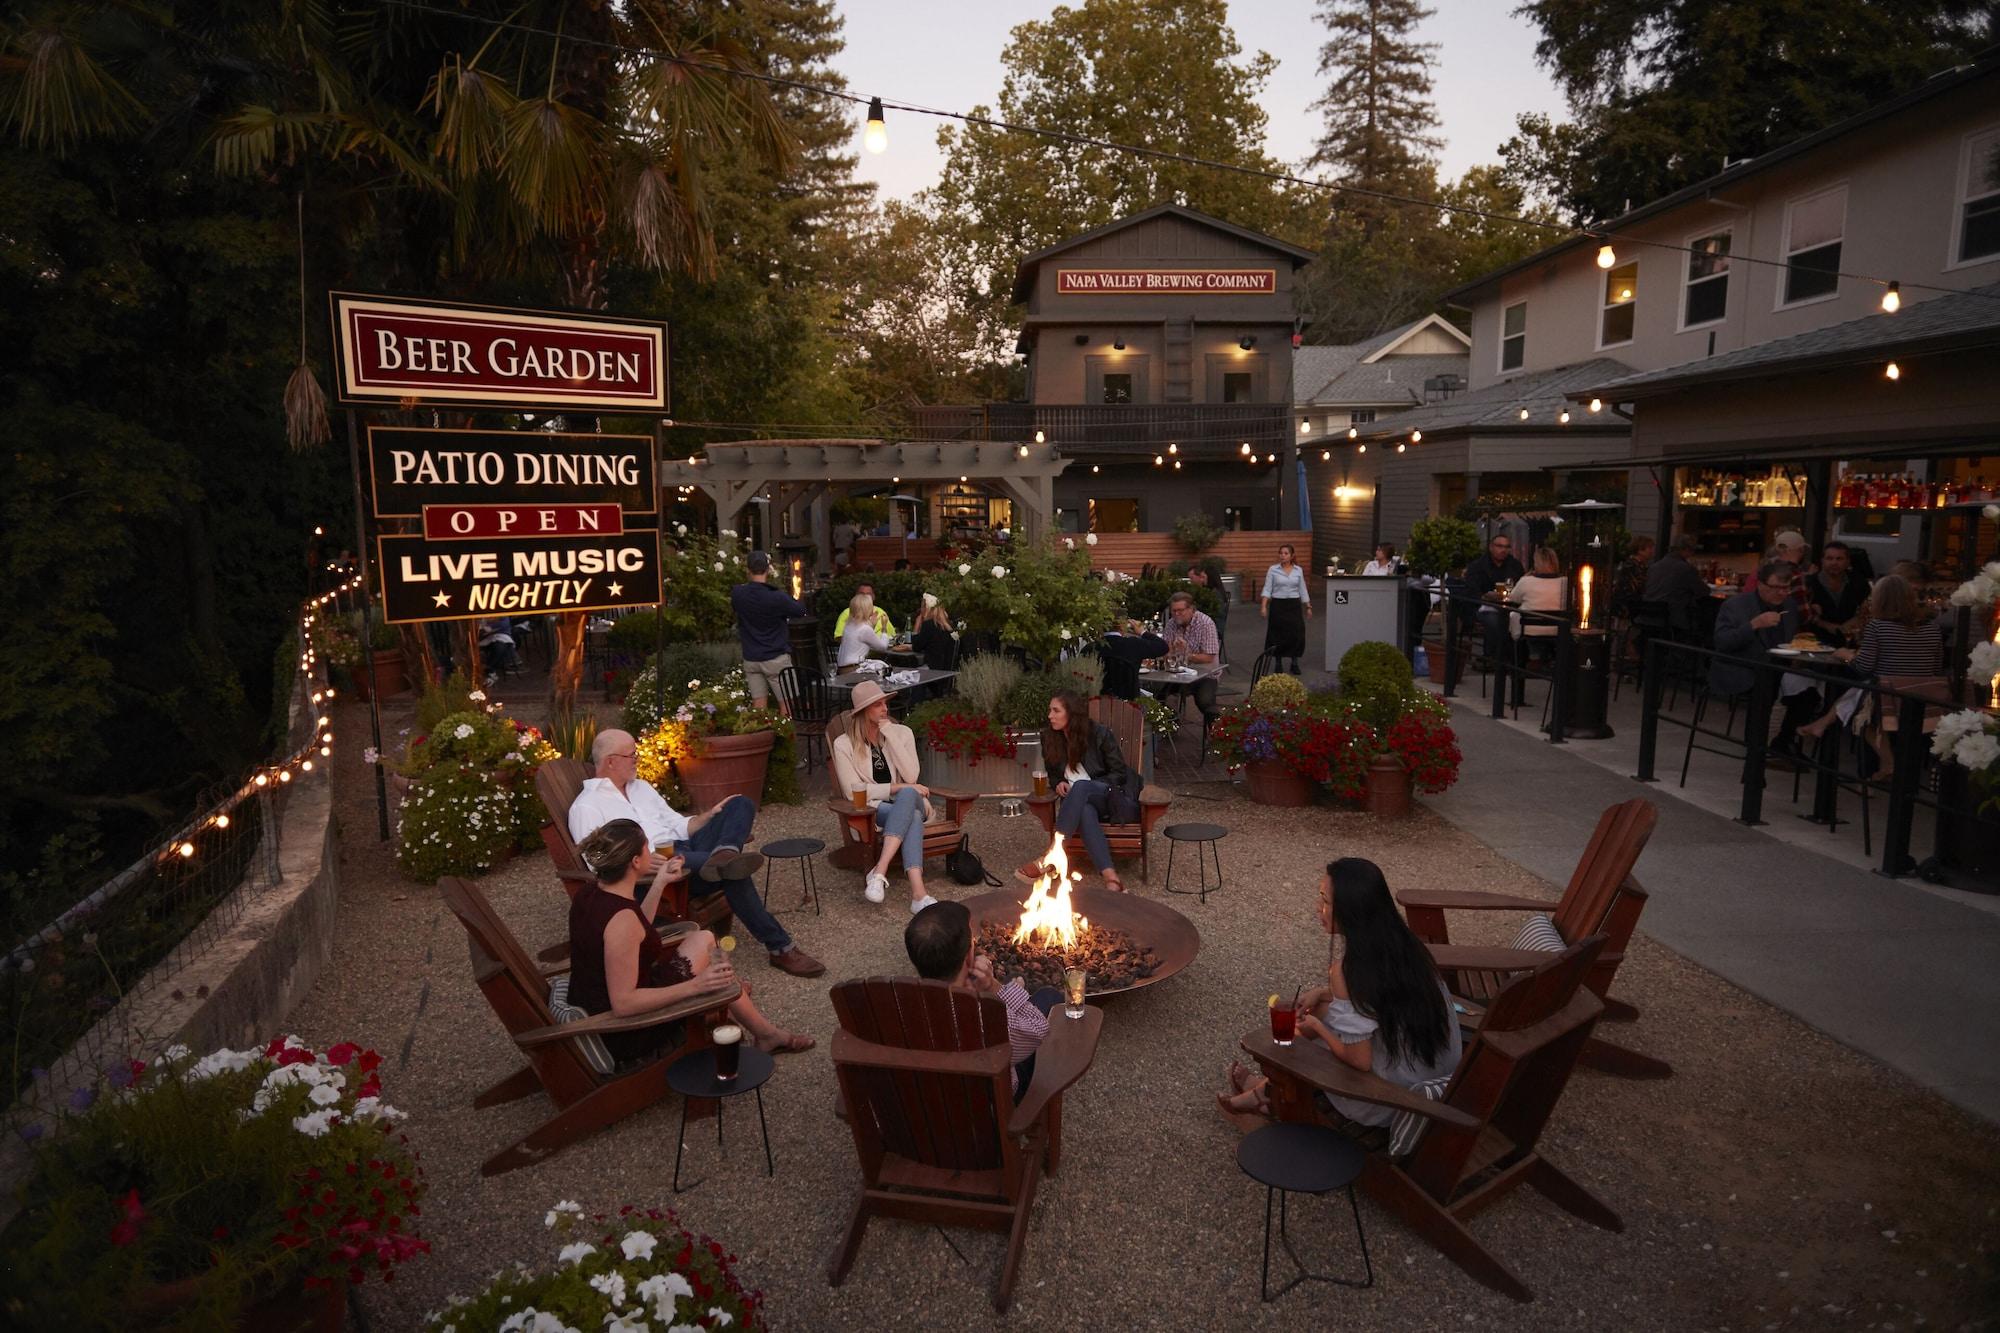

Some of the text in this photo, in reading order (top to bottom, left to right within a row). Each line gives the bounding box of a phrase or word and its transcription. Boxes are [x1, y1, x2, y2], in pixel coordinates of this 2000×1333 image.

[1066, 273, 1267, 288] NAPA VALLEY BREWING COMPANY
[374, 329, 641, 383] BEER GARDEN
[391, 450, 641, 486] PATIO DINING
[450, 509, 600, 534] OPEN
[400, 547, 645, 582] LIVE MUSIC
[468, 578, 592, 611] NIGHTLY
